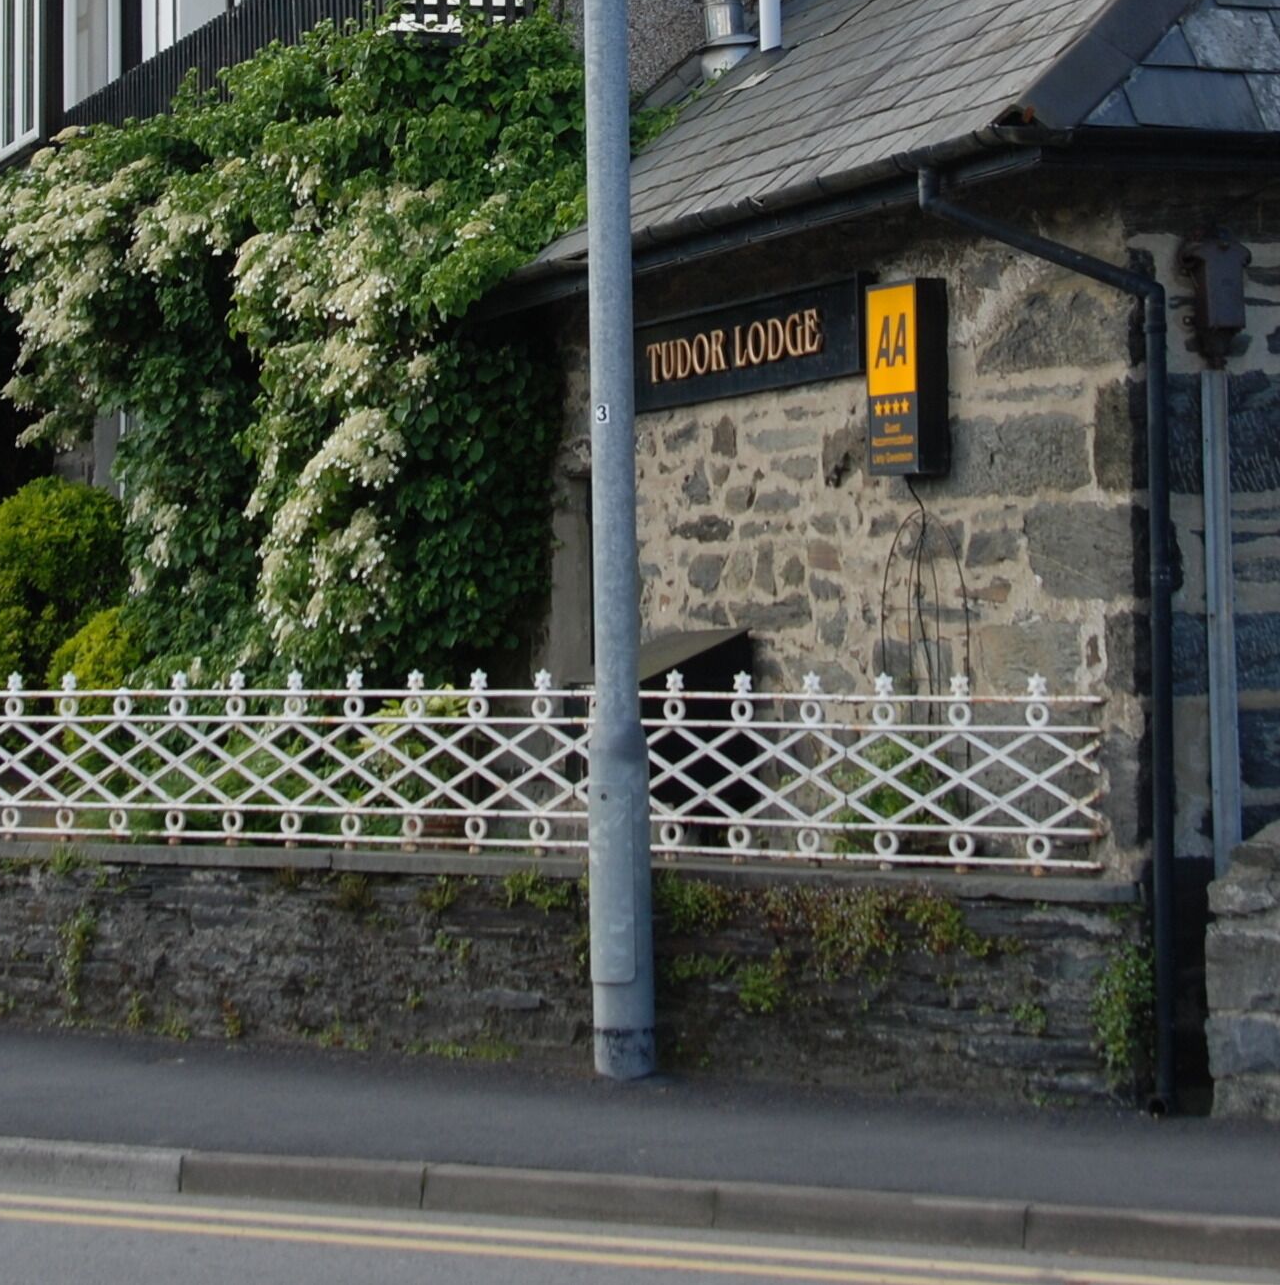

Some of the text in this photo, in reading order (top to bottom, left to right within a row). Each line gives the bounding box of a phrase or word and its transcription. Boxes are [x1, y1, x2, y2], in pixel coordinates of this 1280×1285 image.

[646, 307, 823, 384] TUDOR LODGE
[875, 312, 907, 369] AA
[596, 406, 608, 421] 3
